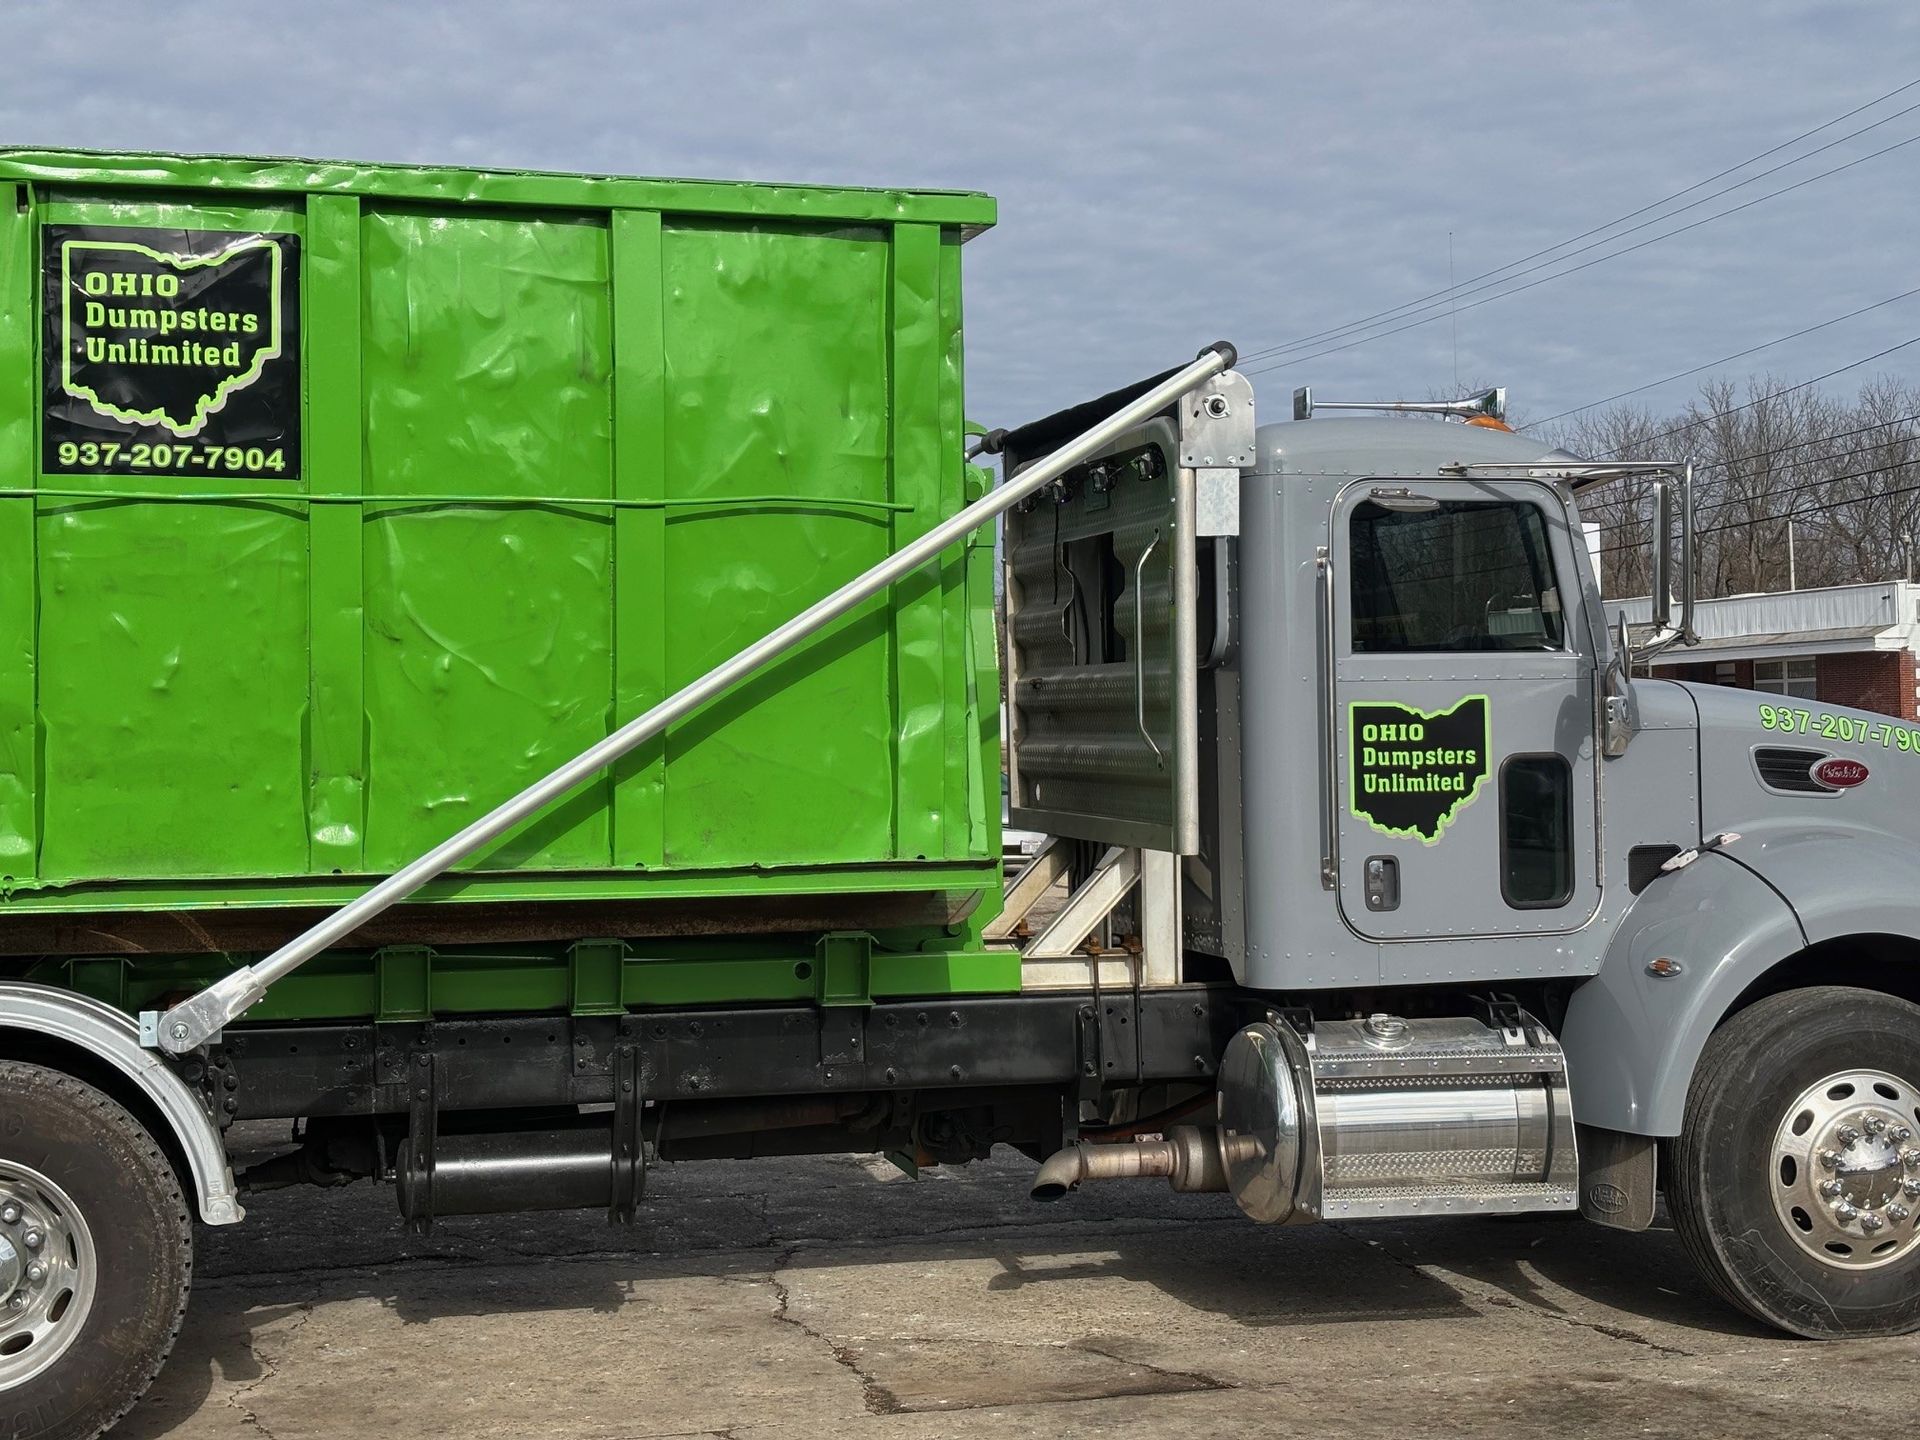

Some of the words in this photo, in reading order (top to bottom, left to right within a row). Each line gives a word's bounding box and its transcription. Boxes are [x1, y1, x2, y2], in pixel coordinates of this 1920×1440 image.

[85, 272, 179, 297] OHIO
[85, 302, 258, 335] Dumpsters
[85, 337, 241, 367] Unlimited
[58, 442, 286, 472] 937-207-7904
[1362, 723, 1424, 742] OHIO
[1362, 747, 1477, 770] Dumpsters
[1363, 772, 1465, 793] Unlimited
